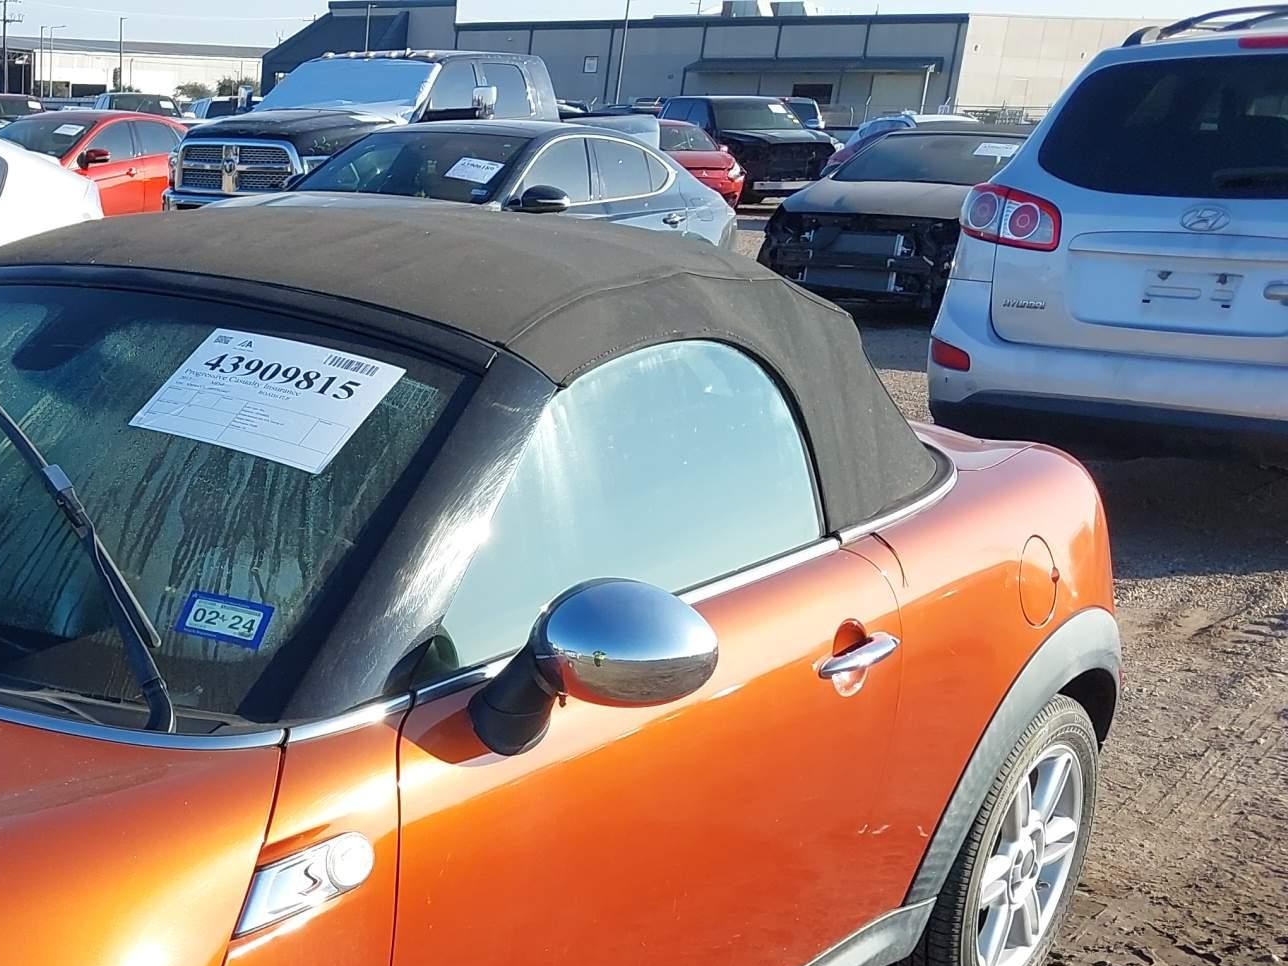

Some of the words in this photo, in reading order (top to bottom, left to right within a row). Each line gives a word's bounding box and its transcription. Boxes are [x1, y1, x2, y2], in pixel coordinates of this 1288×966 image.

[1001, 299, 1047, 310] HYUNDAI
[203, 353, 362, 400] 43909815
[193, 607, 220, 626] 02
[228, 615, 256, 633] 24
